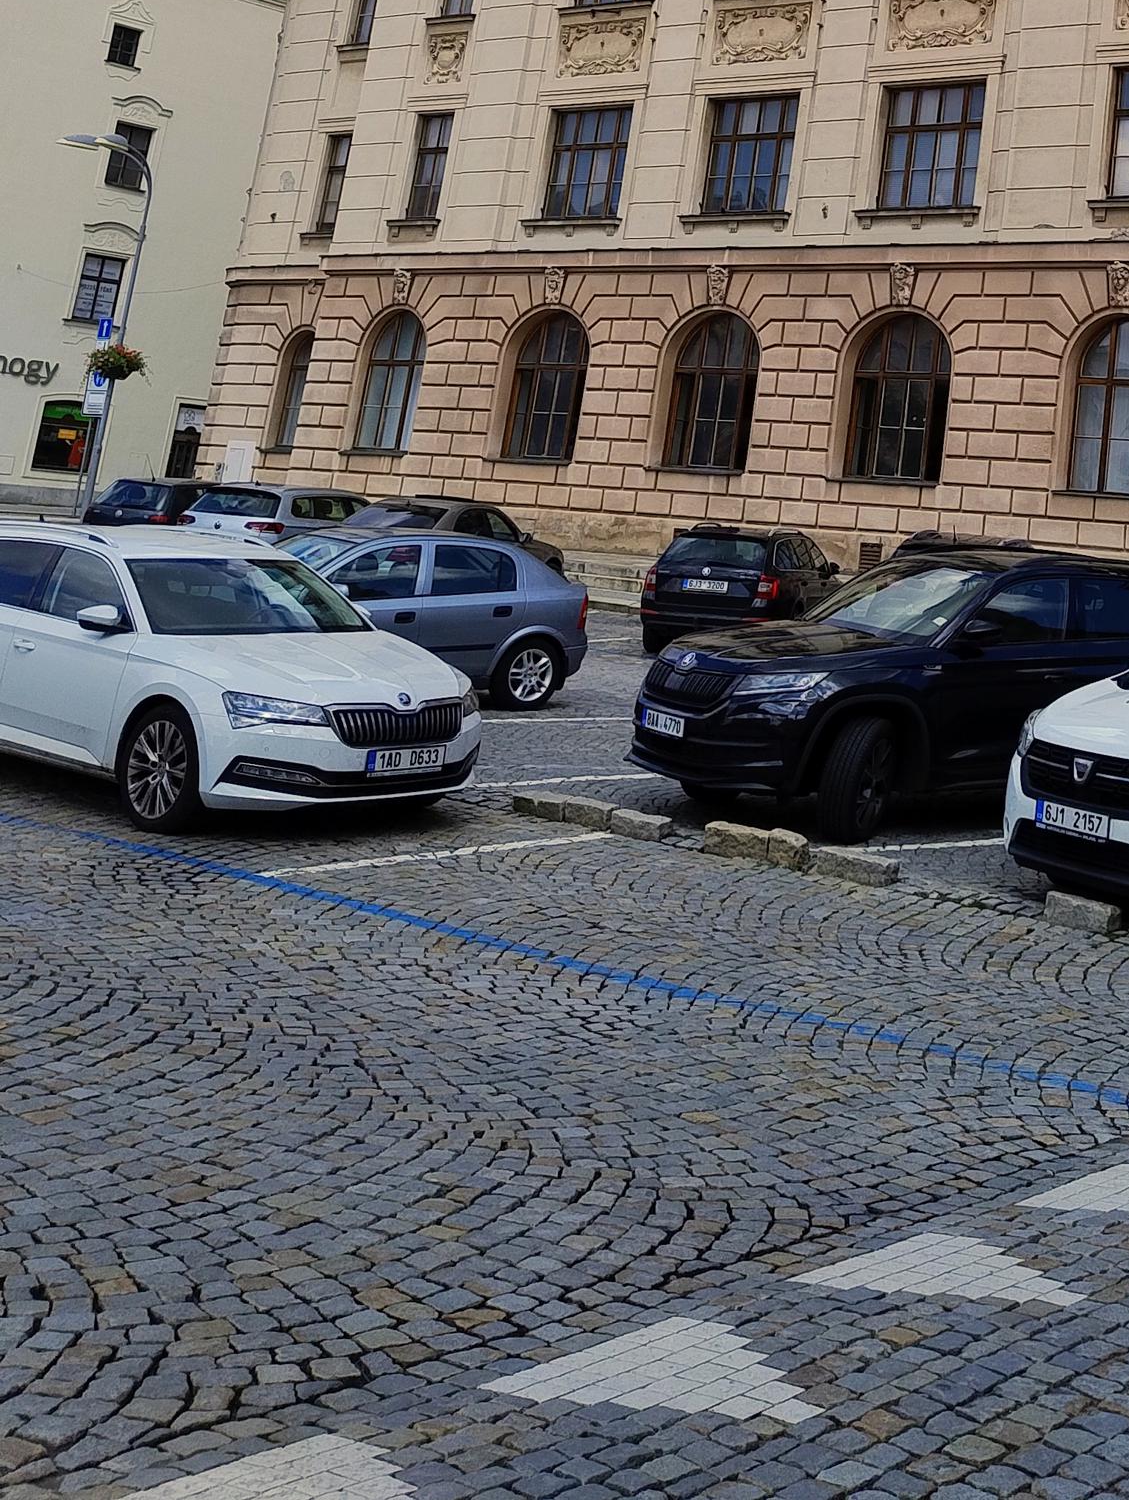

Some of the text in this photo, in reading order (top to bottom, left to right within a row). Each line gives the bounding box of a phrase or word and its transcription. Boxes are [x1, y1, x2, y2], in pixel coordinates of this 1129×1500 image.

[663, 716, 681, 734] 4770
[379, 751, 402, 769] 1AD
[1044, 804, 1065, 825] 6J1
[1072, 811, 1103, 834] 2157
